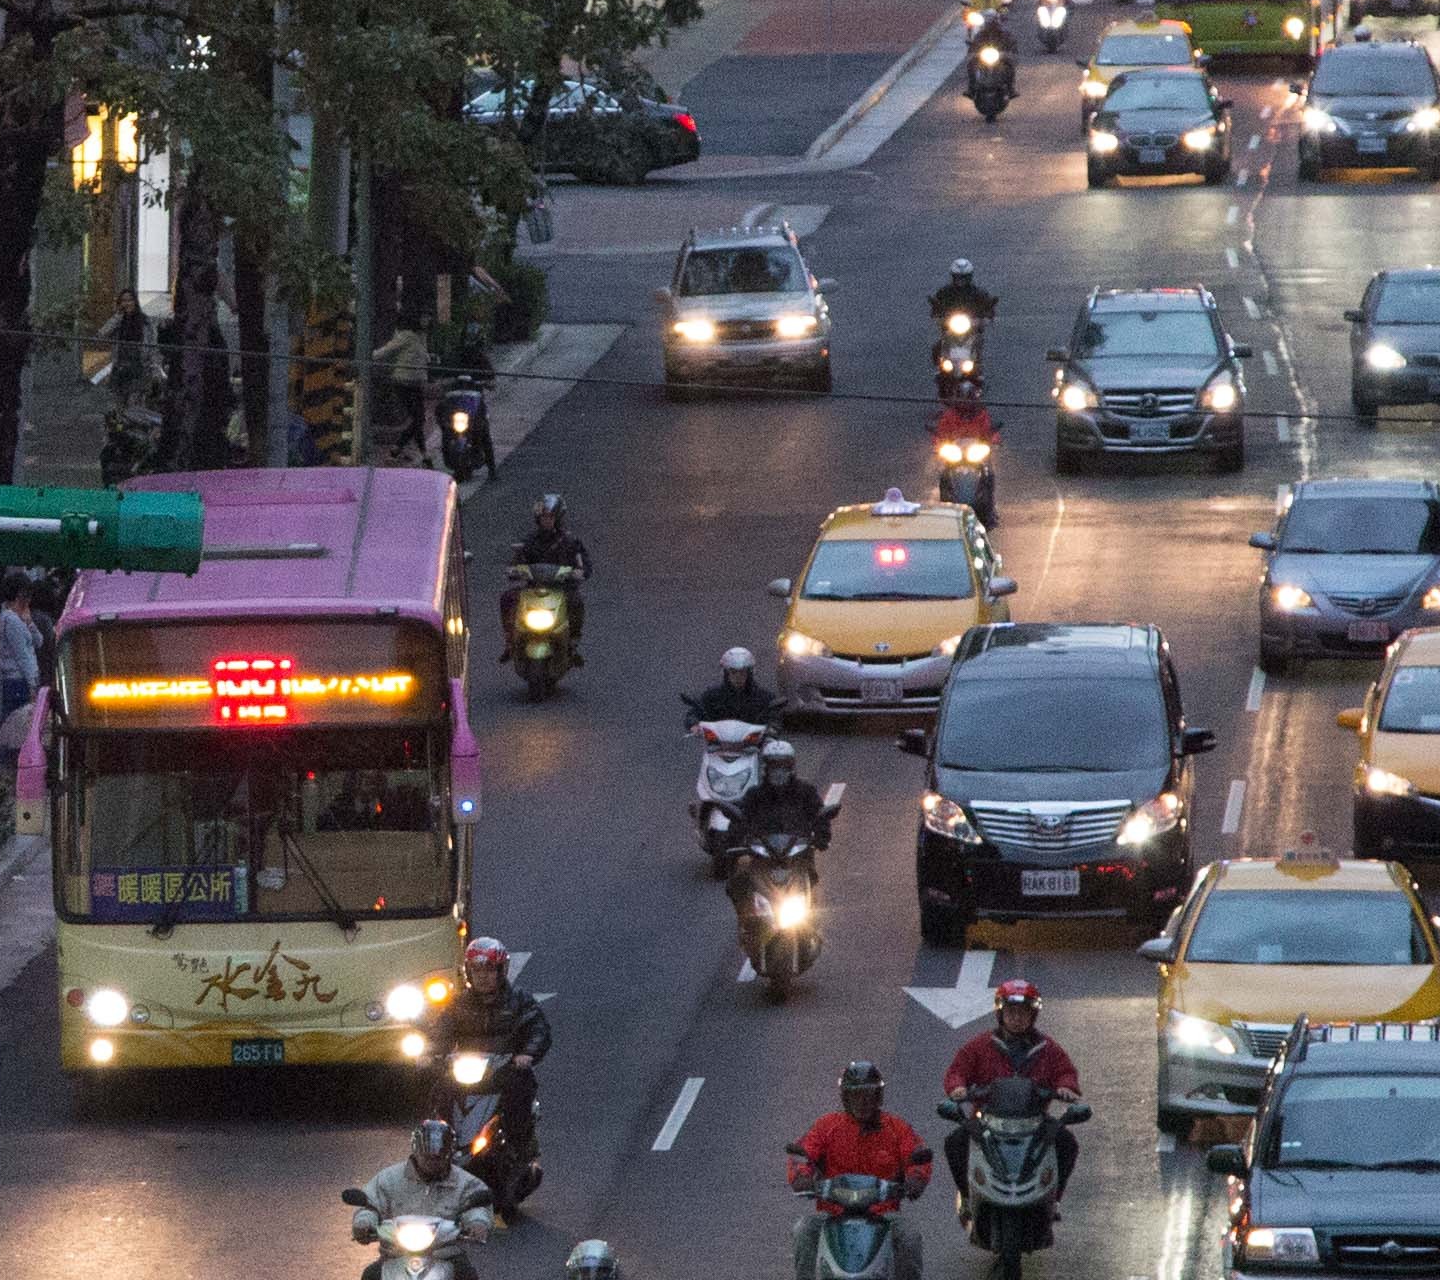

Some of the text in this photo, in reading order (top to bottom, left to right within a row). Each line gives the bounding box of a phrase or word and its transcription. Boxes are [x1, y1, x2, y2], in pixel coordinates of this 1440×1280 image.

[118, 871, 232, 904] 暖暖區公所
